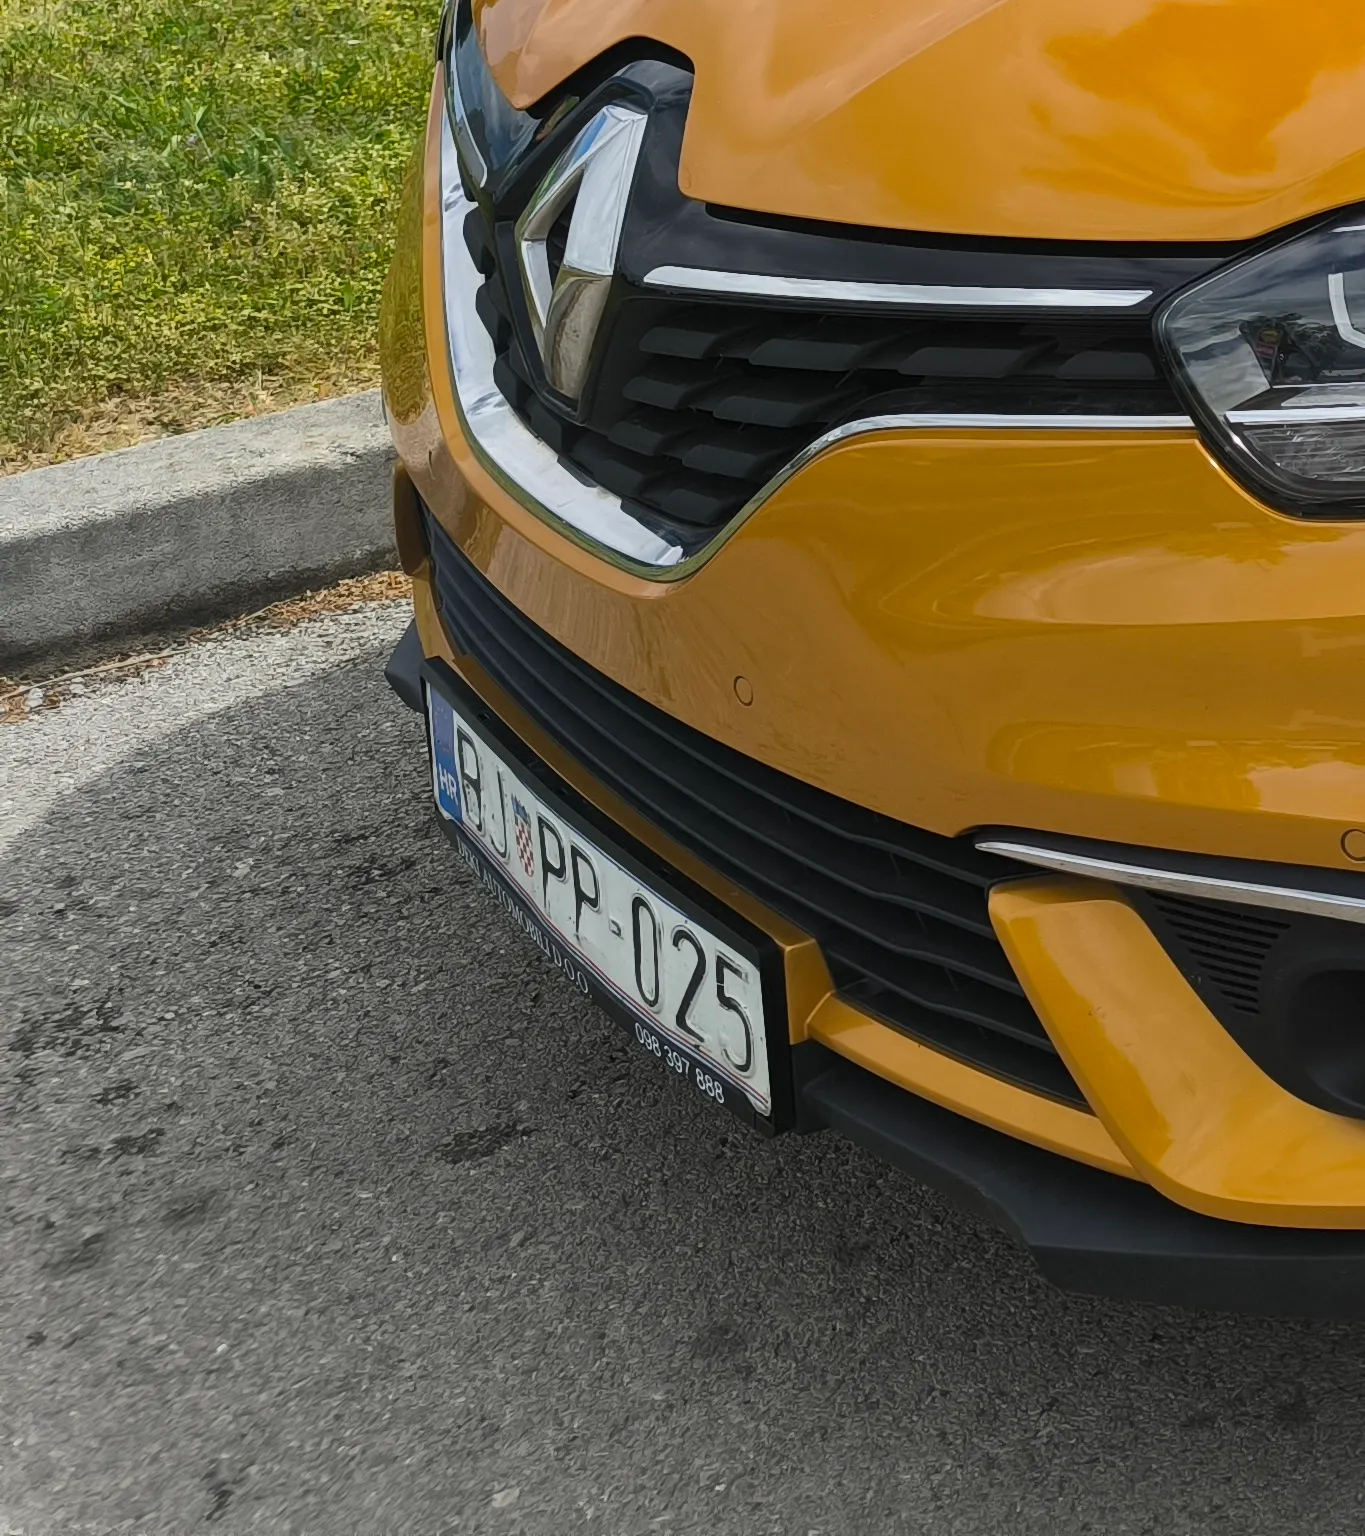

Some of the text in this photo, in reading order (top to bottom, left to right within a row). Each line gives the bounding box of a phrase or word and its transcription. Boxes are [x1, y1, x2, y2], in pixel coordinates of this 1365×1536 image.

[438, 763, 459, 805] HR
[483, 867, 552, 958] AUTOMOBILI
[634, 1022, 725, 1104] 098 397 888
